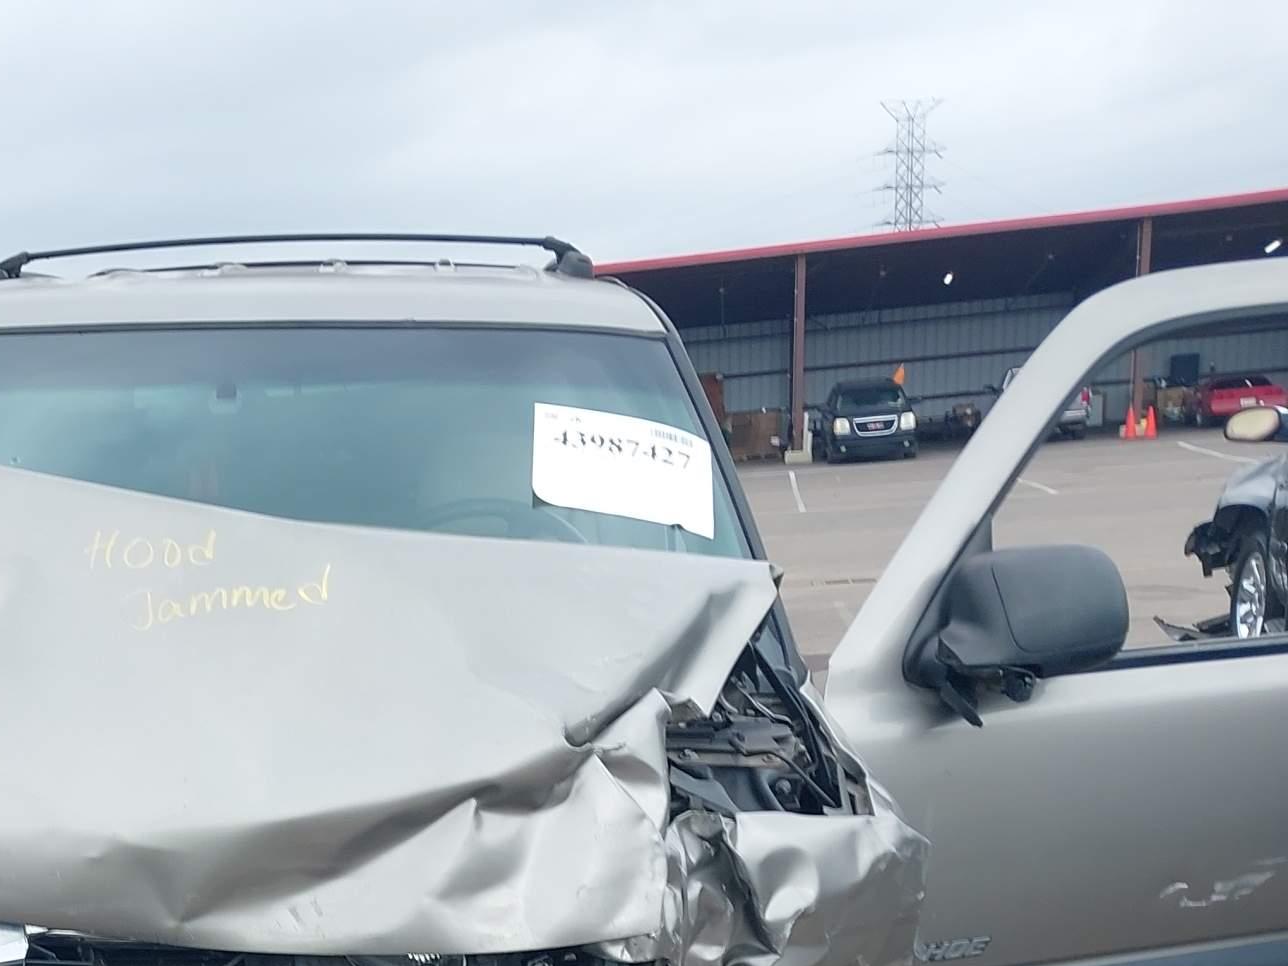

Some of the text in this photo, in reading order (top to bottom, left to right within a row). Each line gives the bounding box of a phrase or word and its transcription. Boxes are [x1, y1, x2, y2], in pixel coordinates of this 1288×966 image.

[553, 429, 691, 469] 43987427
[125, 563, 331, 631] Jammed
[918, 936, 991, 961] HOE
